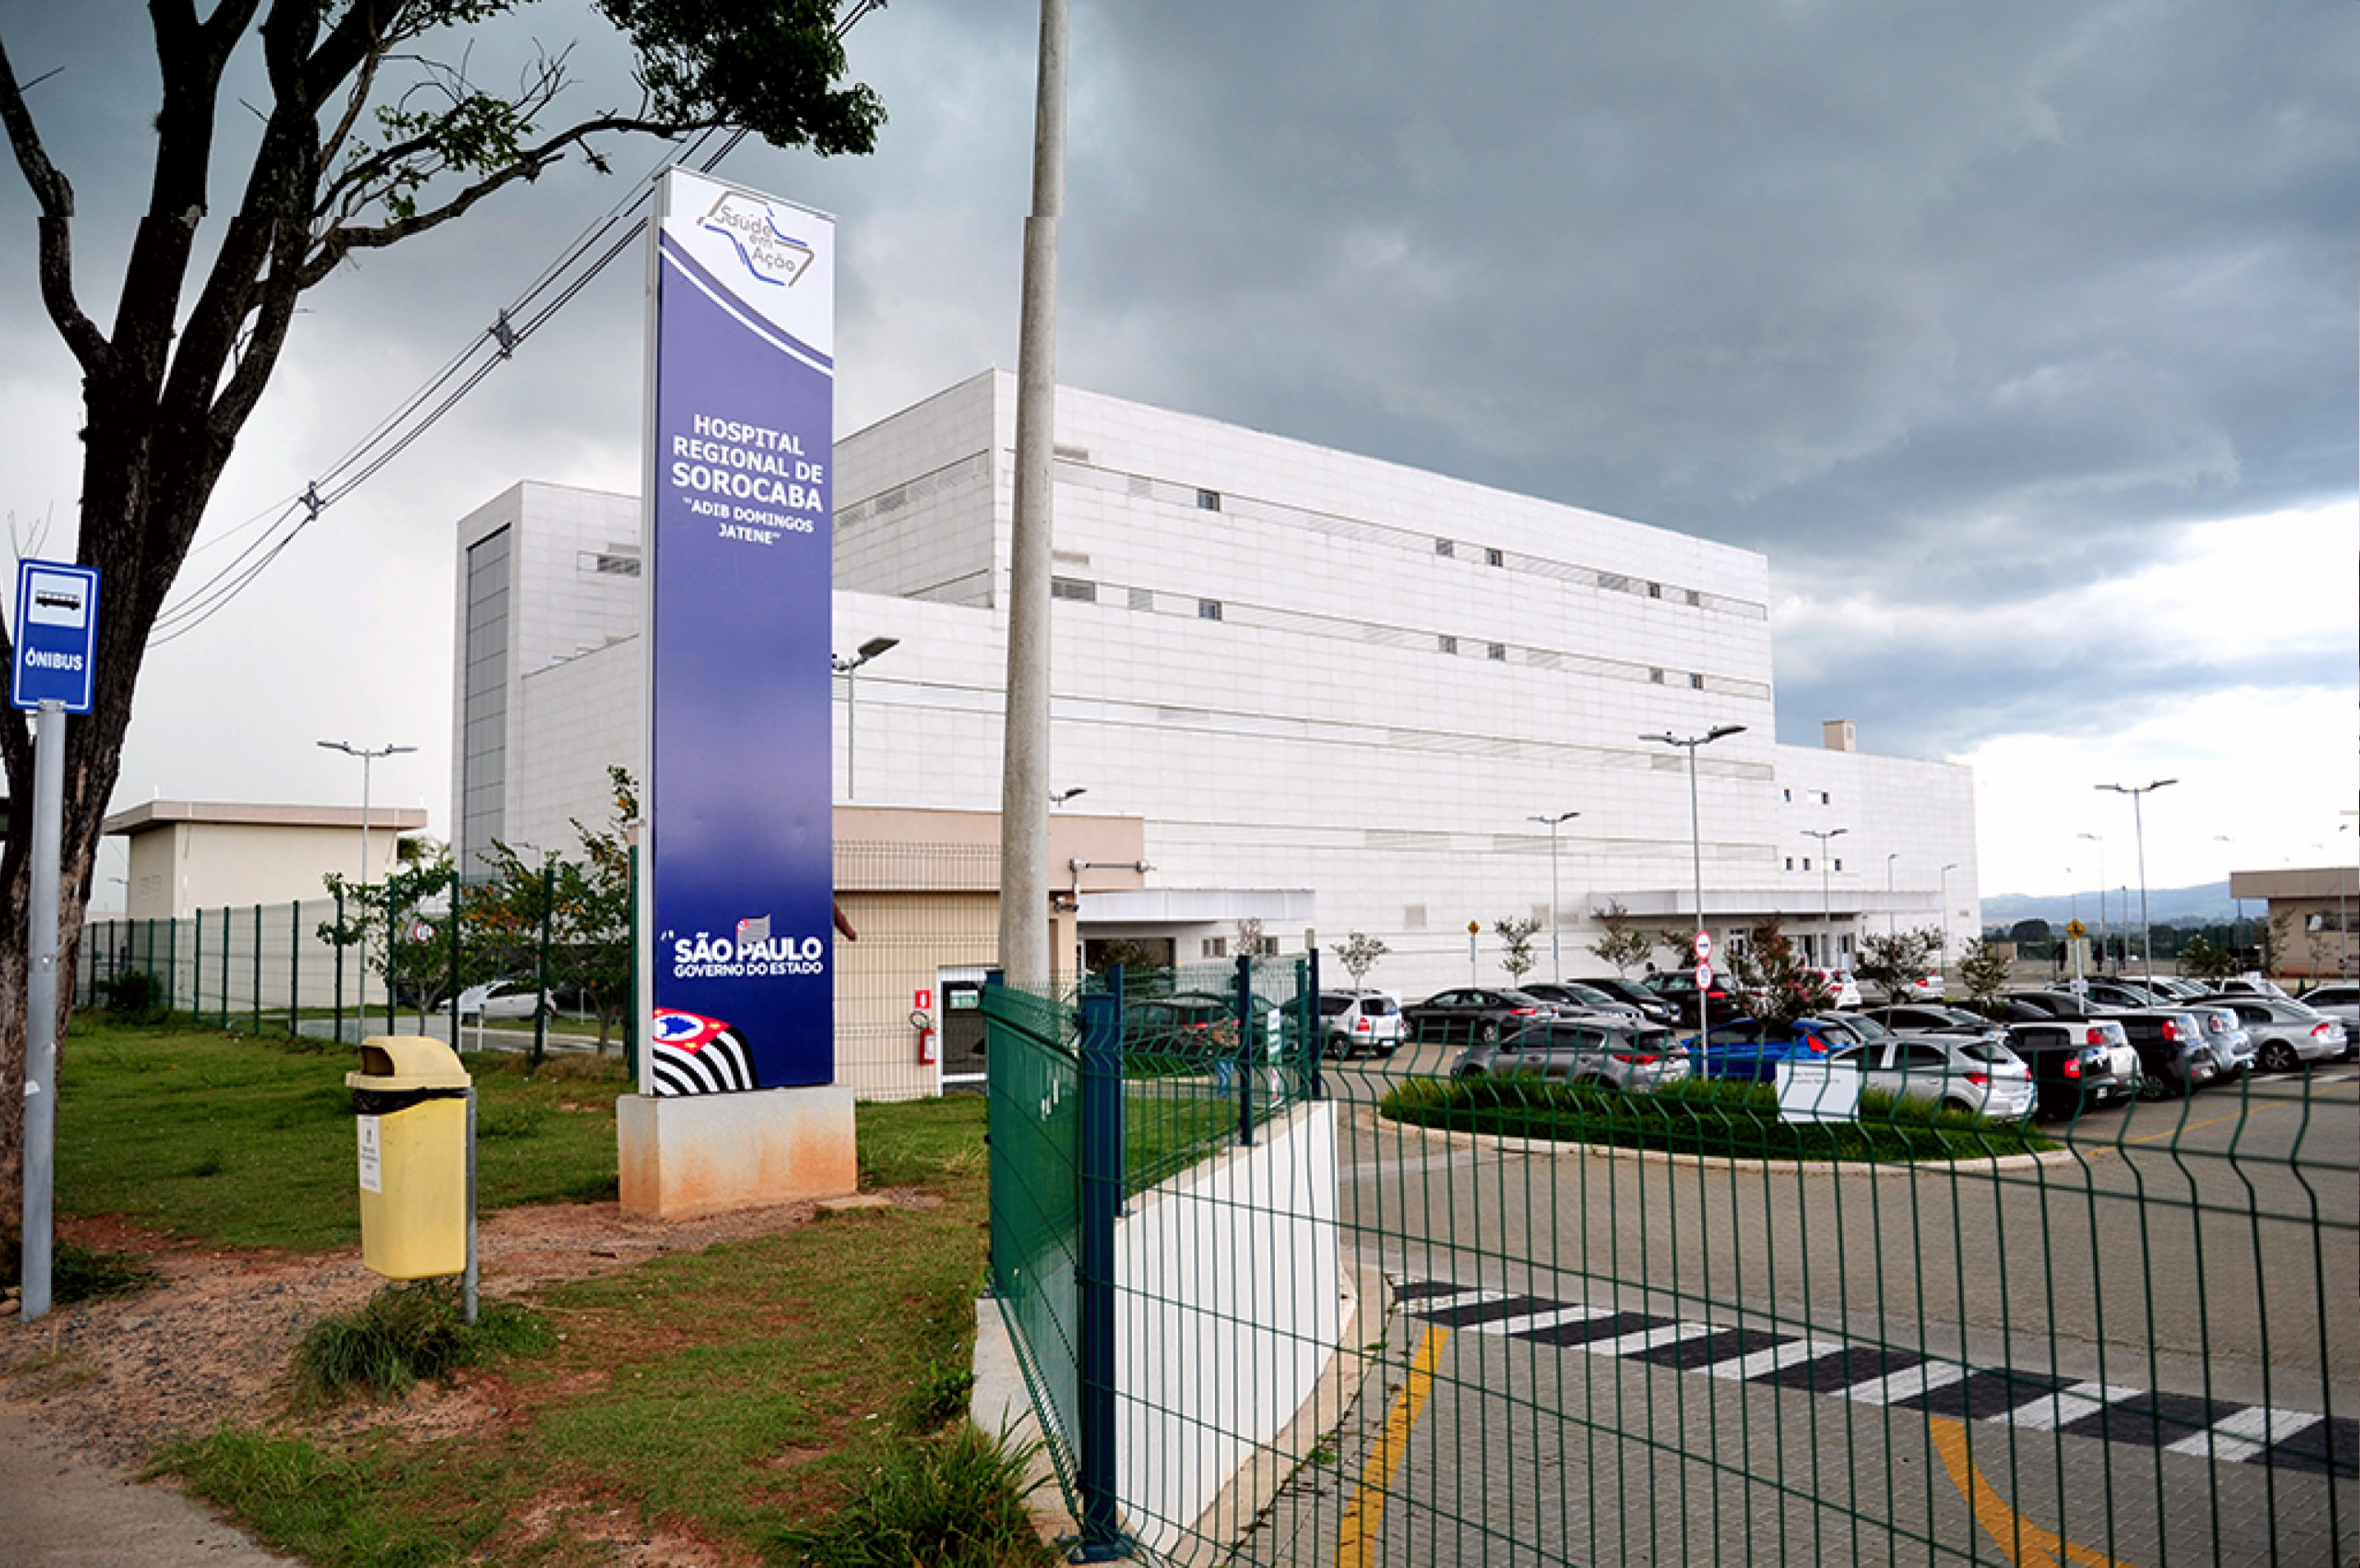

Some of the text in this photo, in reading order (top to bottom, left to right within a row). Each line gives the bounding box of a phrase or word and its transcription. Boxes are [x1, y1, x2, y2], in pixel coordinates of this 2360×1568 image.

[715, 205, 772, 237] Saúde
[752, 246, 796, 273] Ação
[693, 414, 805, 457] HOSPITAL
[673, 435, 823, 485] REGIONAL DE
[672, 462, 823, 513] SOROCABA
[733, 506, 814, 533] DOMINGOS
[674, 931, 823, 963] SÃO PAULO
[674, 961, 823, 978] GOVERNO DO ESTADO
